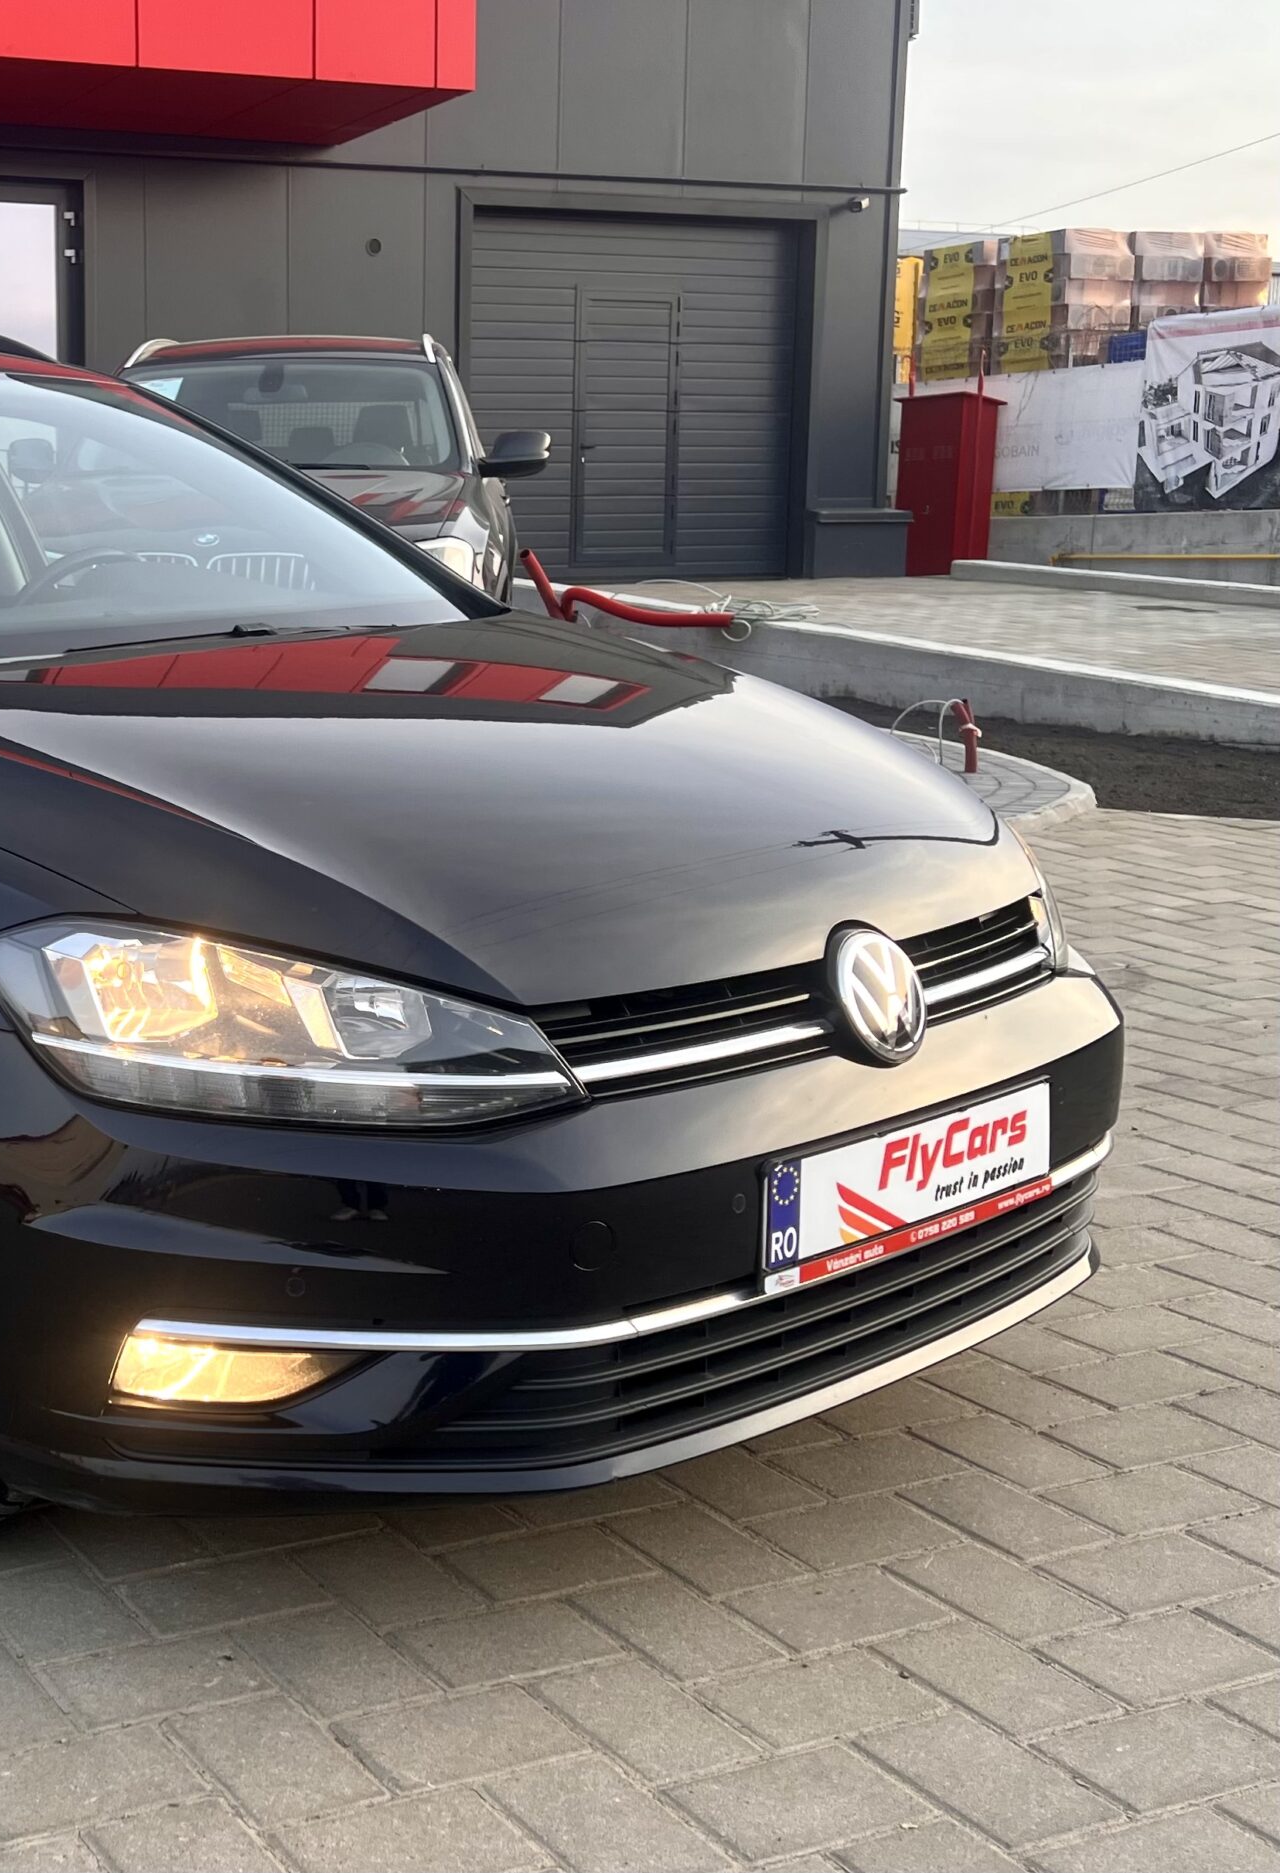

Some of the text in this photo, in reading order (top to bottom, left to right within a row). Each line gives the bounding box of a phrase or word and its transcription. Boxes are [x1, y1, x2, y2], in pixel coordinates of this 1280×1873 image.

[943, 252, 960, 264] EVO
[1018, 271, 1038, 283] EVO
[937, 315, 957, 327] EVO
[1013, 337, 1034, 349] EVO
[994, 501, 1014, 511] EVO
[878, 1110, 1028, 1192] FlyCars
[935, 1157, 1025, 1202] trust in passion
[941, 1217, 958, 1232] 220
[771, 1226, 797, 1264] RO
[863, 1244, 885, 1260] auto
